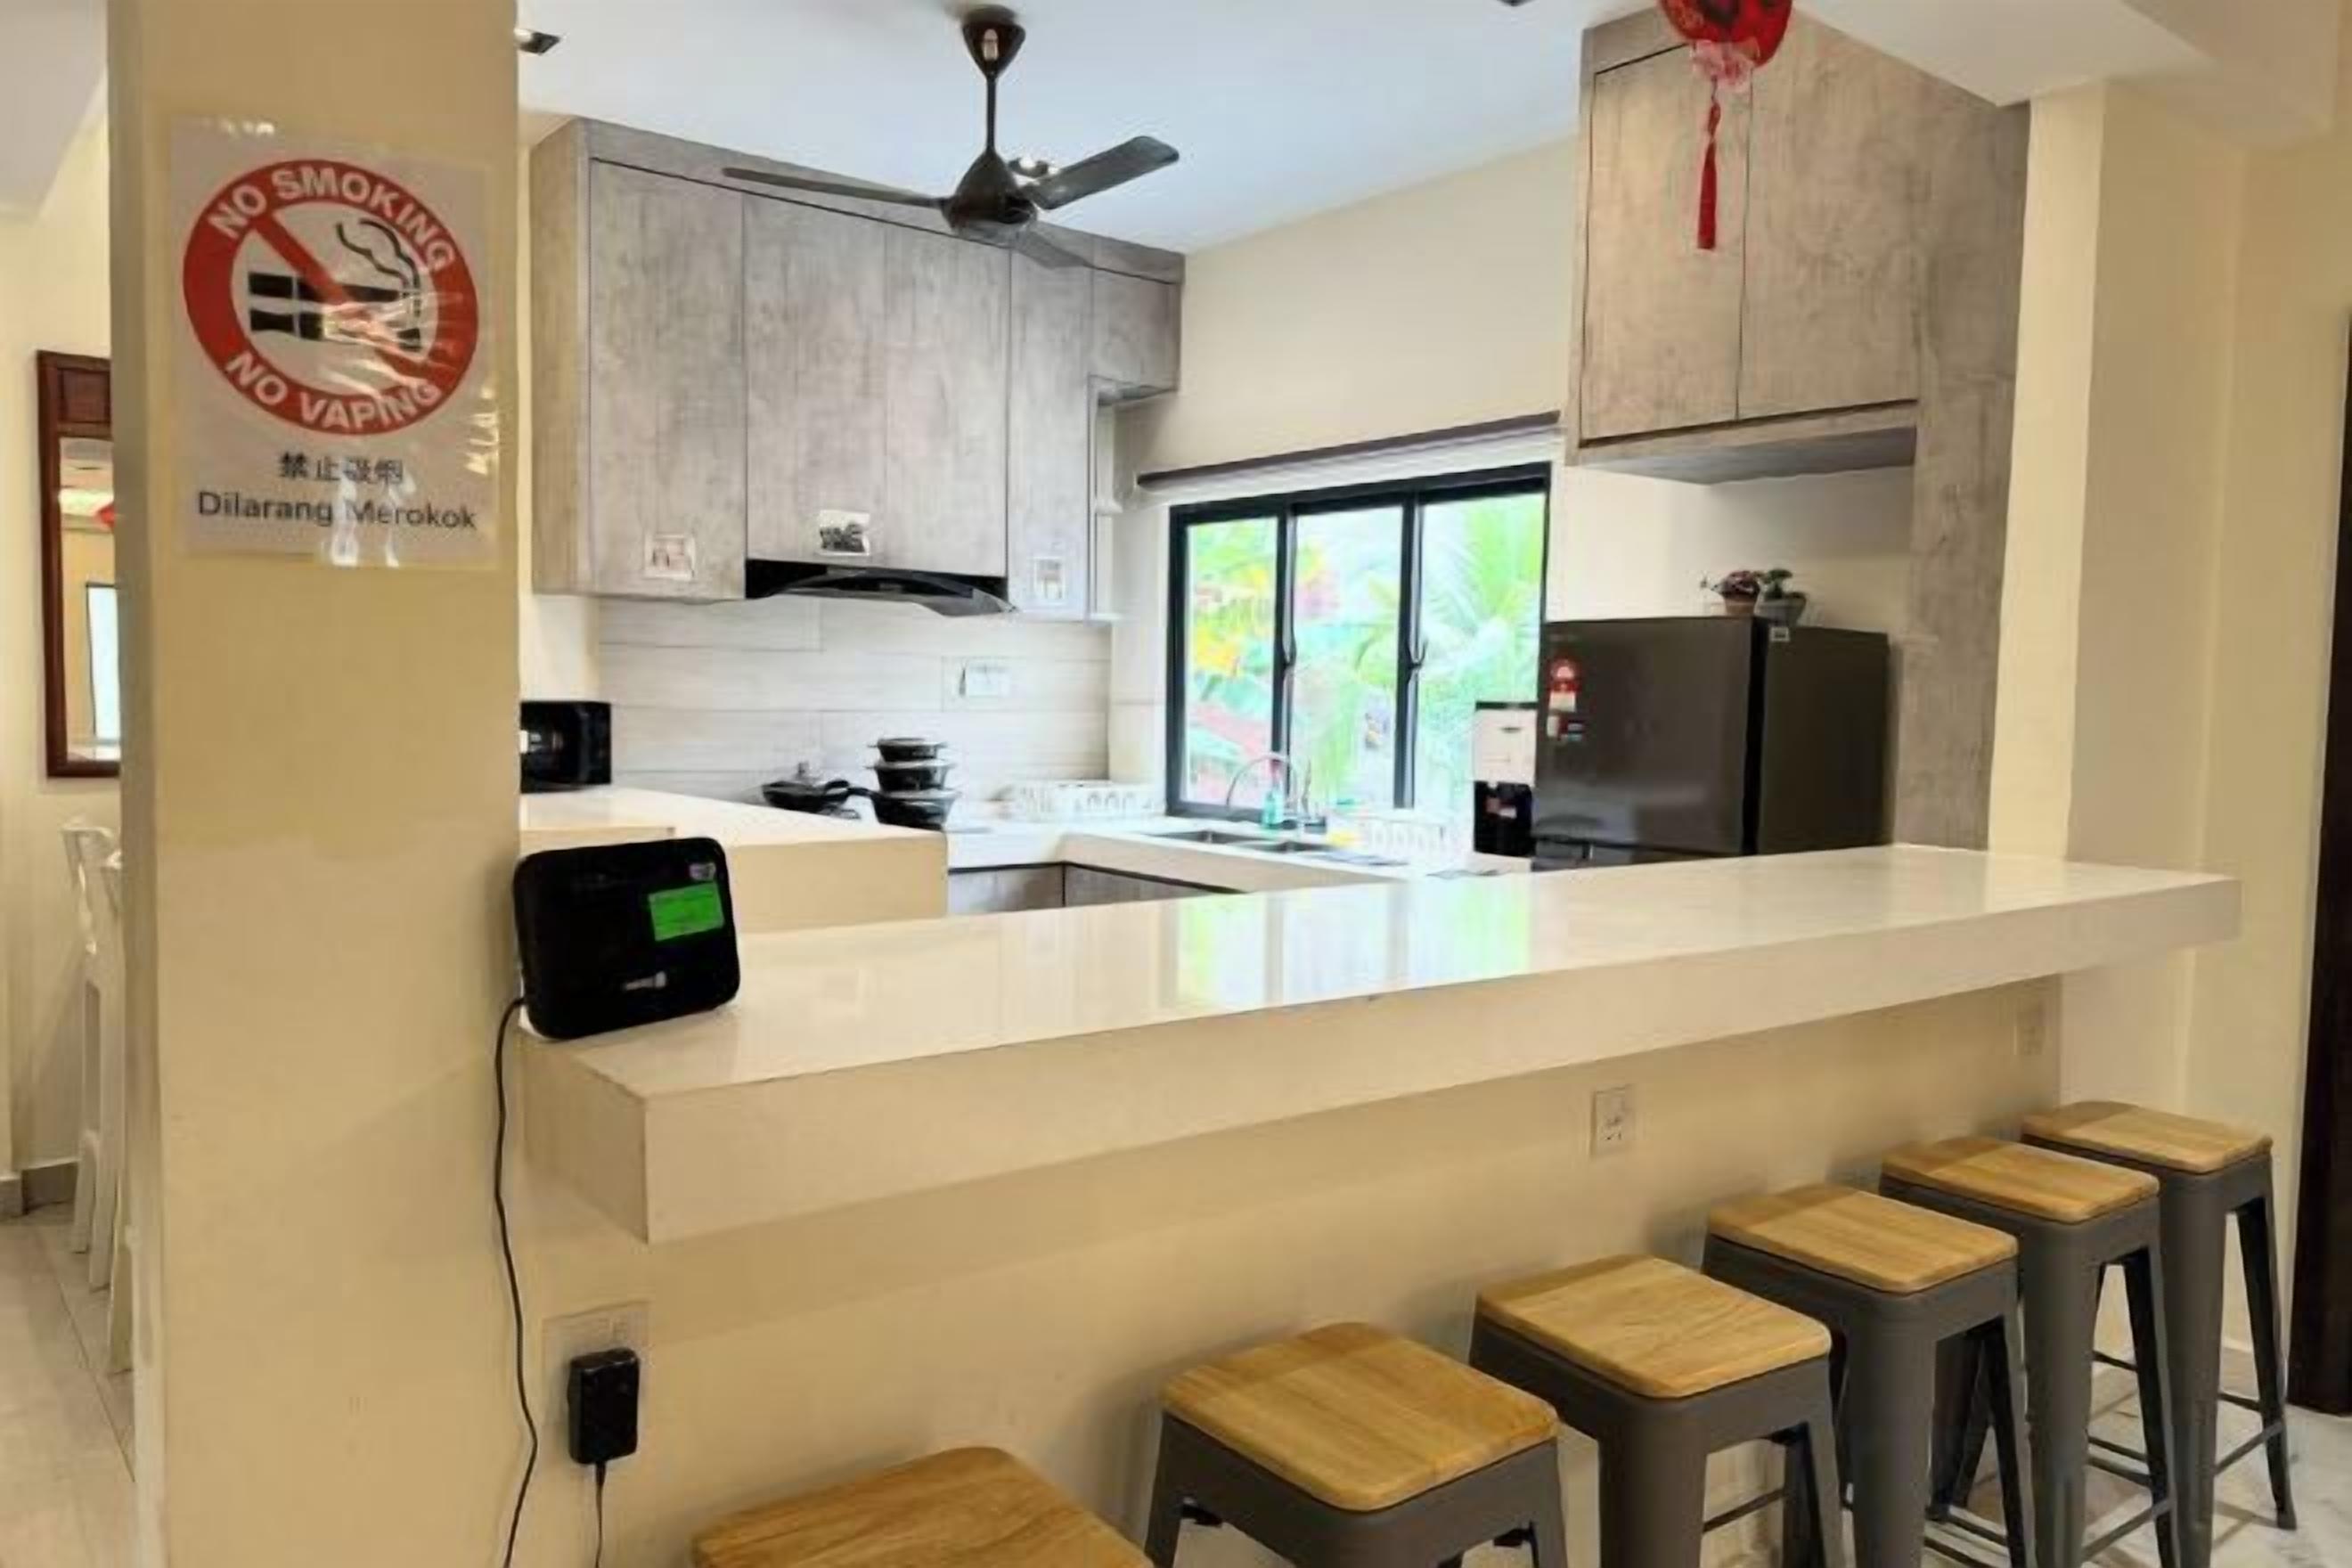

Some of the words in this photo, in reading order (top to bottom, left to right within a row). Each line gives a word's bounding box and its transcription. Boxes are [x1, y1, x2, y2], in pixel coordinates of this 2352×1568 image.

[207, 184, 267, 240] NO
[271, 167, 455, 269] SMOKING
[225, 352, 288, 406] NO
[299, 379, 442, 429] VAPING
[198, 492, 334, 527] Dilarang
[345, 499, 477, 530] Merokok
